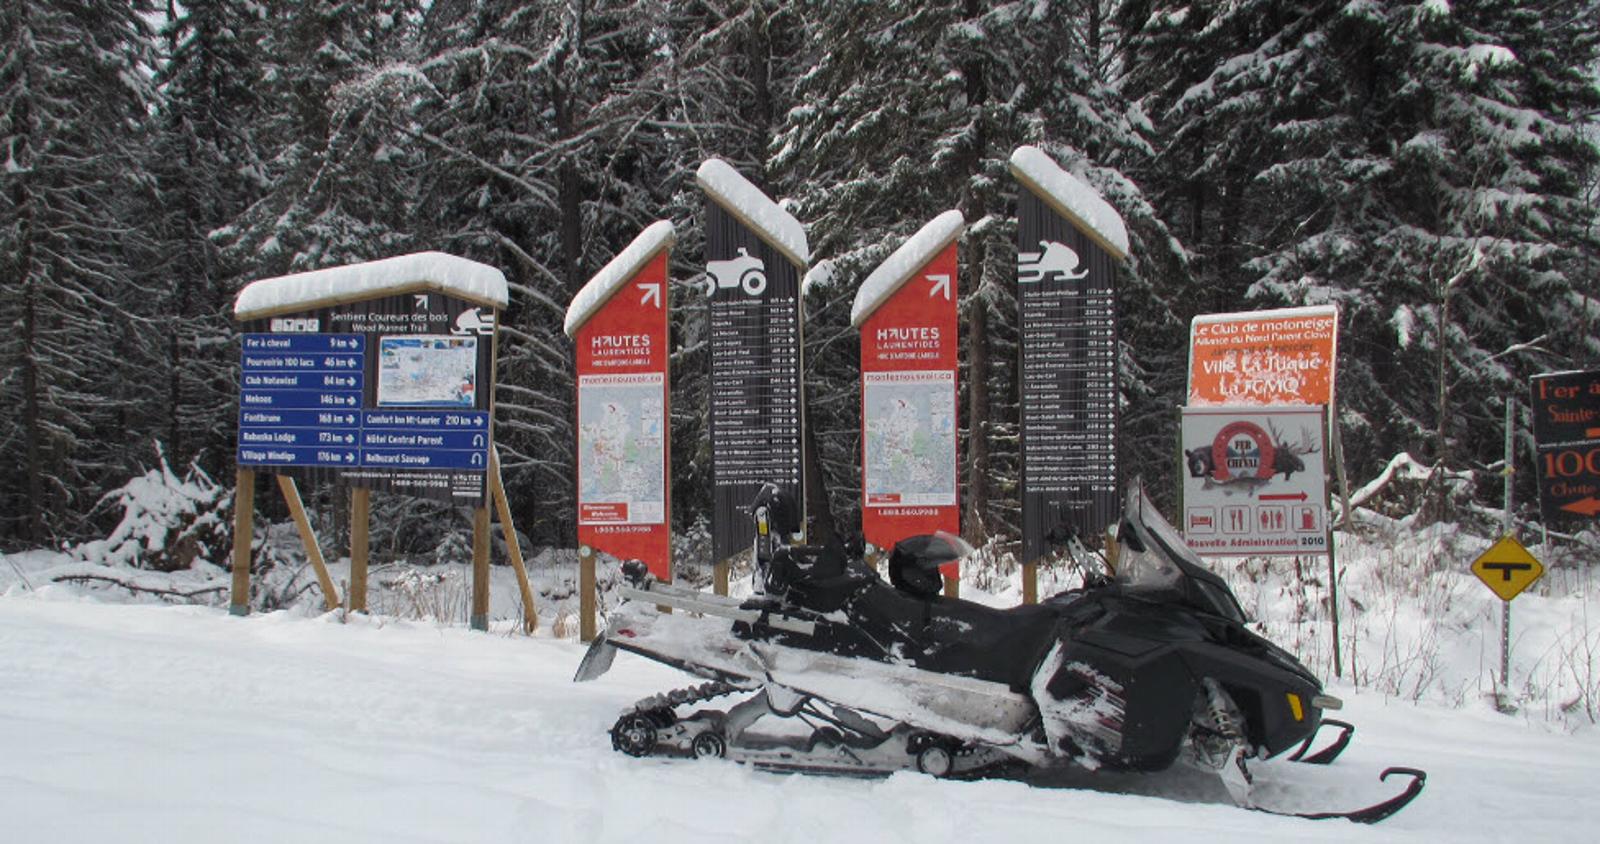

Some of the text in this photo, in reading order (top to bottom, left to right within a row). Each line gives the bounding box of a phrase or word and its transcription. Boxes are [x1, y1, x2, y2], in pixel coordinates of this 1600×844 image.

[330, 312, 448, 322] Sentiers Coureurs des bois
[352, 324, 428, 332] Wood Runner Trail
[1195, 318, 1333, 336] Le Club de motoneige
[877, 327, 940, 340] HAUTES
[246, 338, 290, 347] Fer à cheval
[330, 338, 347, 347] 9 km
[592, 334, 651, 348] HAUTES
[1195, 335, 1229, 346] Alliance
[1231, 336, 1243, 344] du
[1246, 334, 1269, 344] Nord
[1272, 332, 1301, 342] Parent
[876, 341, 940, 350] LAURENTIDES
[592, 348, 651, 356] LAURENTIDES
[284, 357, 299, 366] 100
[300, 358, 314, 367] lacs
[336, 358, 346, 366] km
[1203, 354, 1320, 375] Ville La Tuque
[245, 376, 261, 385] Club
[336, 376, 345, 385] km
[1220, 377, 1238, 394] La
[1539, 378, 1580, 400] Fer
[334, 395, 345, 404] km
[334, 414, 343, 423] km
[367, 414, 394, 425] Comfort
[460, 416, 471, 426] km
[274, 432, 295, 444] Lodge
[319, 433, 343, 442] 173 km
[366, 434, 443, 446] Hôtel Central Parent
[1234, 440, 1252, 450] FER
[242, 450, 295, 462] Village Windigo
[318, 452, 341, 462] 176 km
[400, 454, 430, 464] Sauvage
[1227, 458, 1258, 468] CHEVAL
[1187, 536, 1324, 547] Nouvelle Administration 2010
